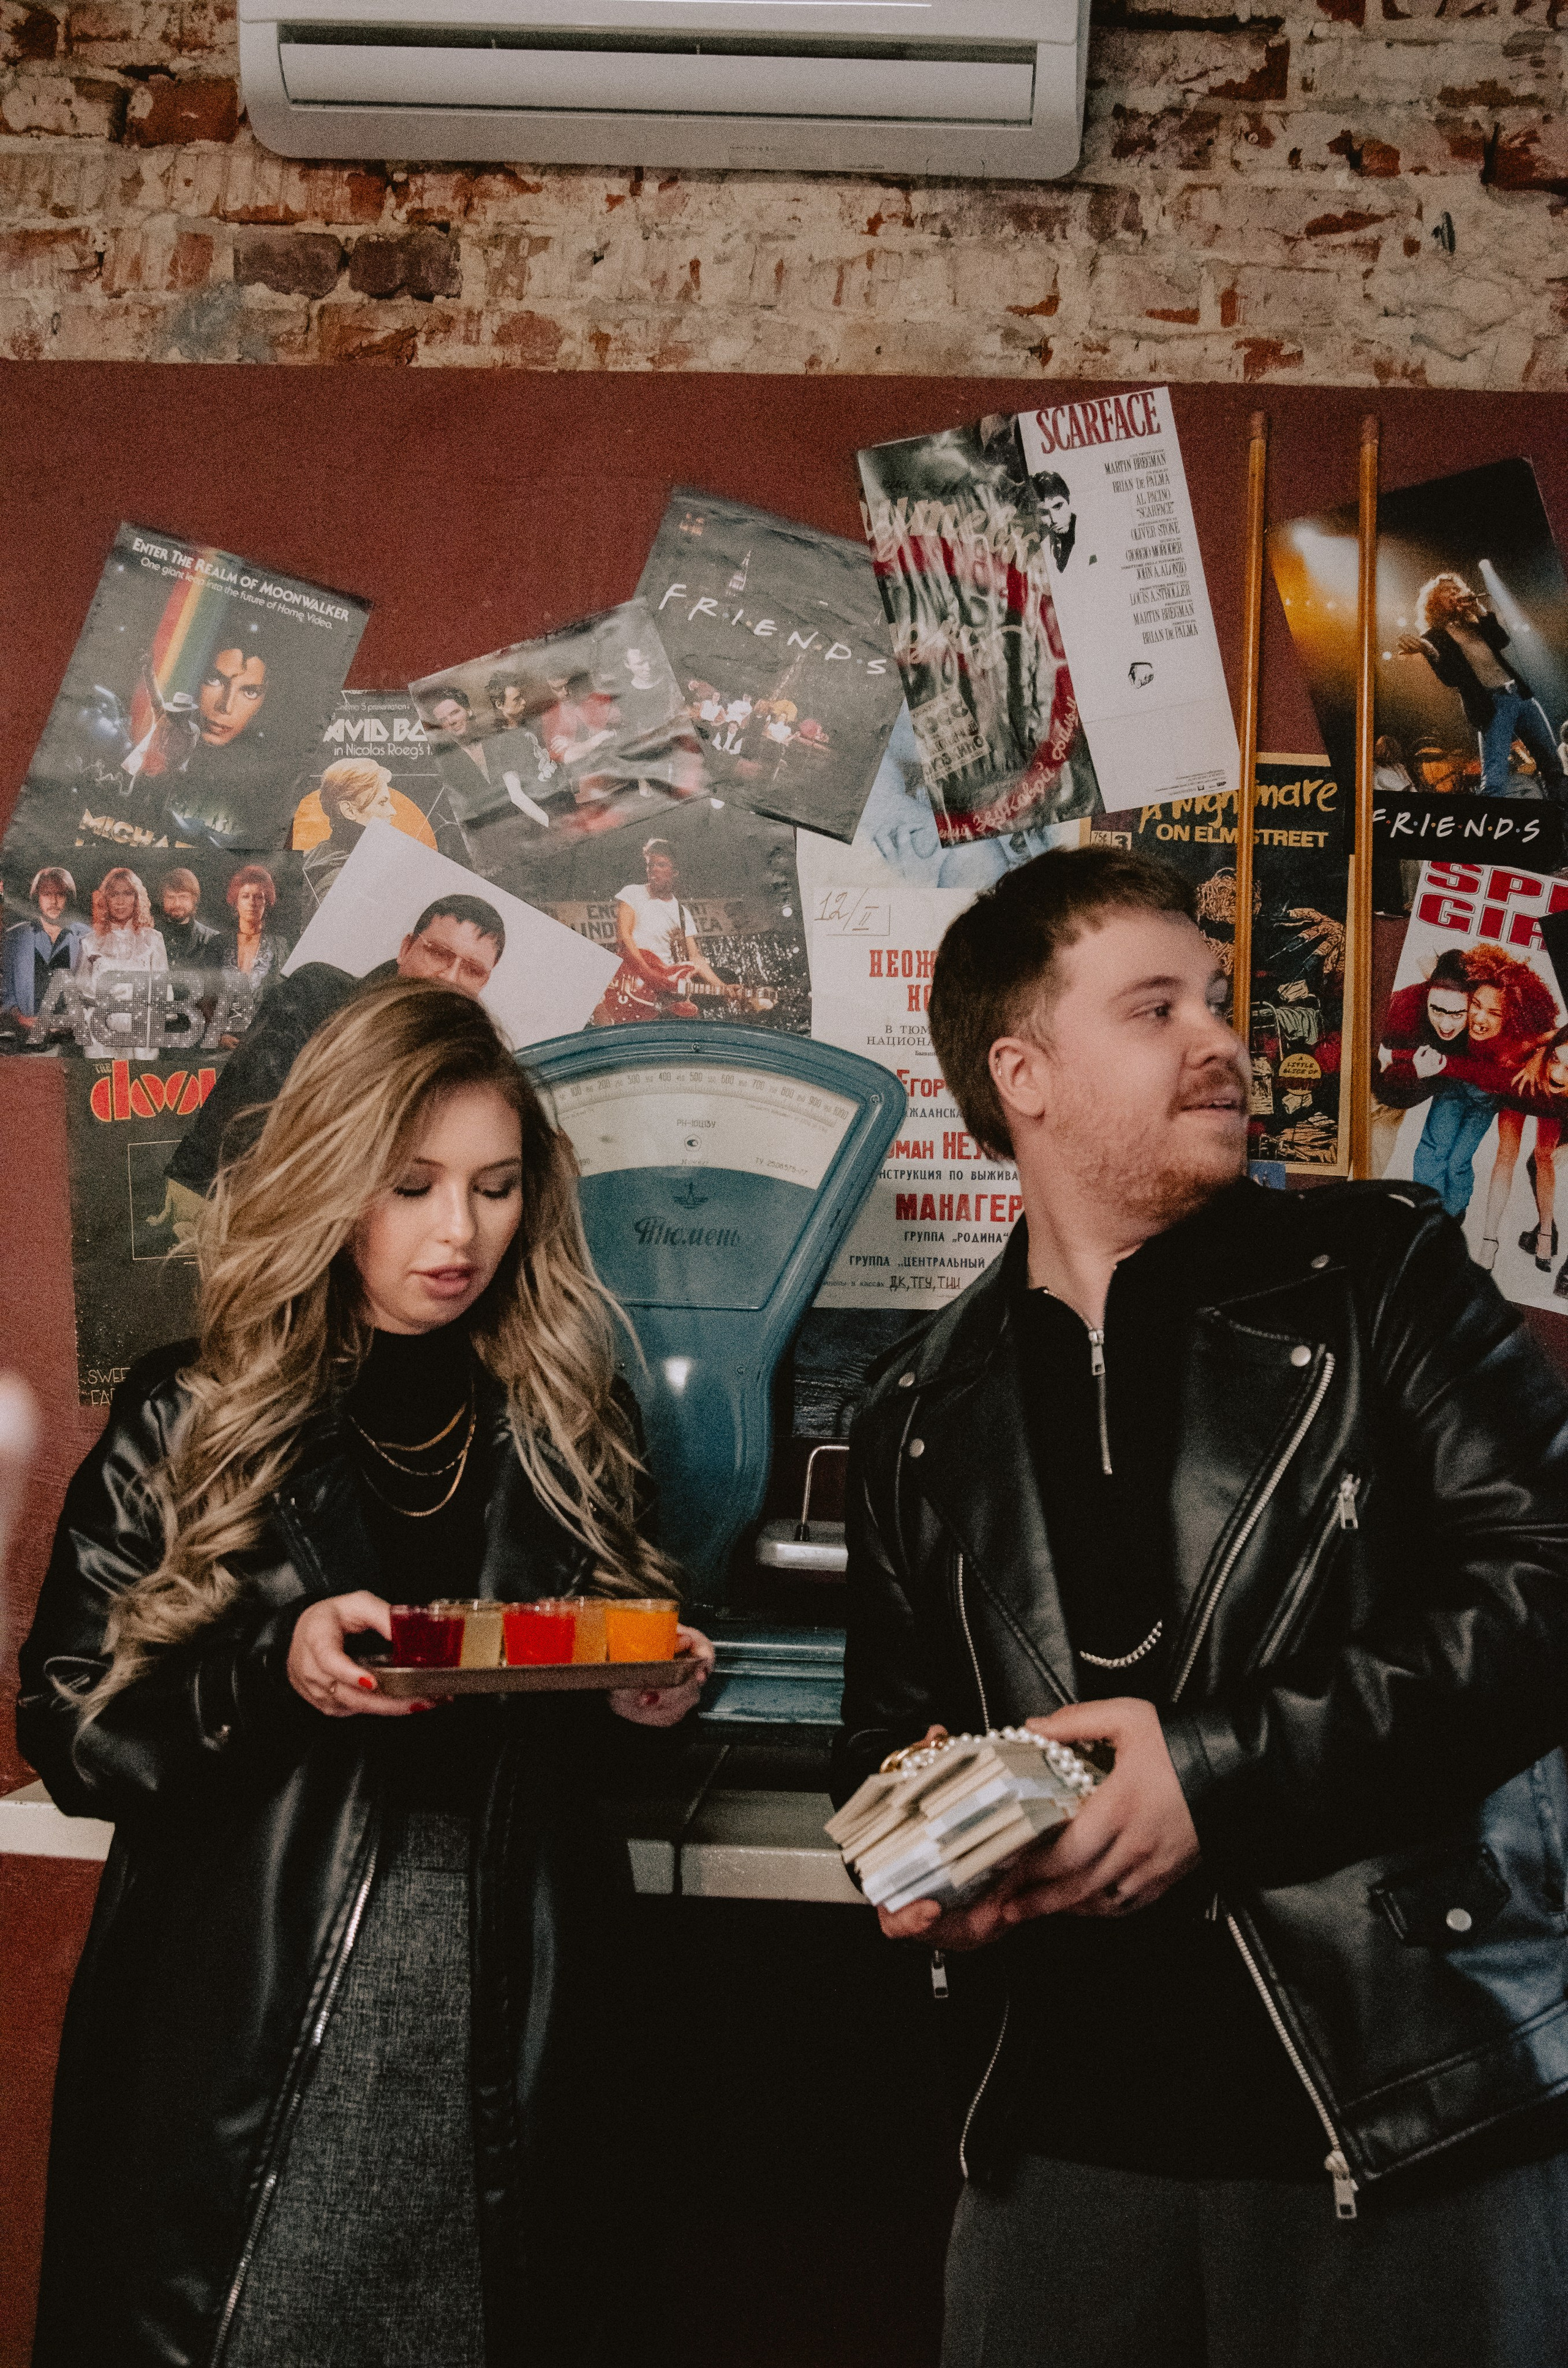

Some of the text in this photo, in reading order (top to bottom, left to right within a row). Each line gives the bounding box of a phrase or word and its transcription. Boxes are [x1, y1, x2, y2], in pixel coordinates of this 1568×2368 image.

[1036, 391, 1161, 454] SCARFACE
[1104, 459, 1131, 474] MARTIN
[1112, 478, 1133, 493] BRIAN
[1145, 473, 1170, 488] PALMA
[1137, 489, 1170, 505] AL PACINO
[1131, 526, 1156, 540] OLIVER
[1158, 521, 1180, 536] STONE
[1161, 561, 1187, 577] ALONZO
[132, 537, 349, 622] ENTER THE REALM OF MOONWALKER
[141, 557, 161, 570] One
[162, 567, 184, 580] giant
[206, 579, 223, 592] into
[224, 586, 239, 597] the
[239, 591, 265, 606] future
[266, 601, 277, 610] of
[277, 603, 304, 619] Home
[1129, 591, 1149, 605] LOUIS
[1133, 603, 1194, 625] MARTIN BREGMAN
[1142, 629, 1164, 644] BRIAN
[1175, 624, 1198, 638] PALMA
[323, 719, 390, 742] AVID
[334, 745, 343, 756] in
[346, 743, 385, 756] Nicolas
[388, 743, 424, 759] Roeg's
[1173, 779, 1338, 827] Nighmare
[79, 808, 196, 847] MICHA
[1156, 824, 1189, 841] ON
[1195, 826, 1238, 844] ELM
[869, 949, 938, 978] НЕОЖ
[900, 1026, 929, 1034] ТЮМ
[597, 1079, 611, 1090] 200
[627, 1074, 640, 1084] 300
[658, 1072, 671, 1082] 400
[690, 1072, 703, 1082] 500
[752, 1079, 765, 1091] 700
[879, 1169, 1019, 1181] НСТРУКЦИЯ ПО ВЫЖИВА
[904, 1231, 944, 1243] ГРУППА
[849, 1255, 890, 1266] ГРУППА
